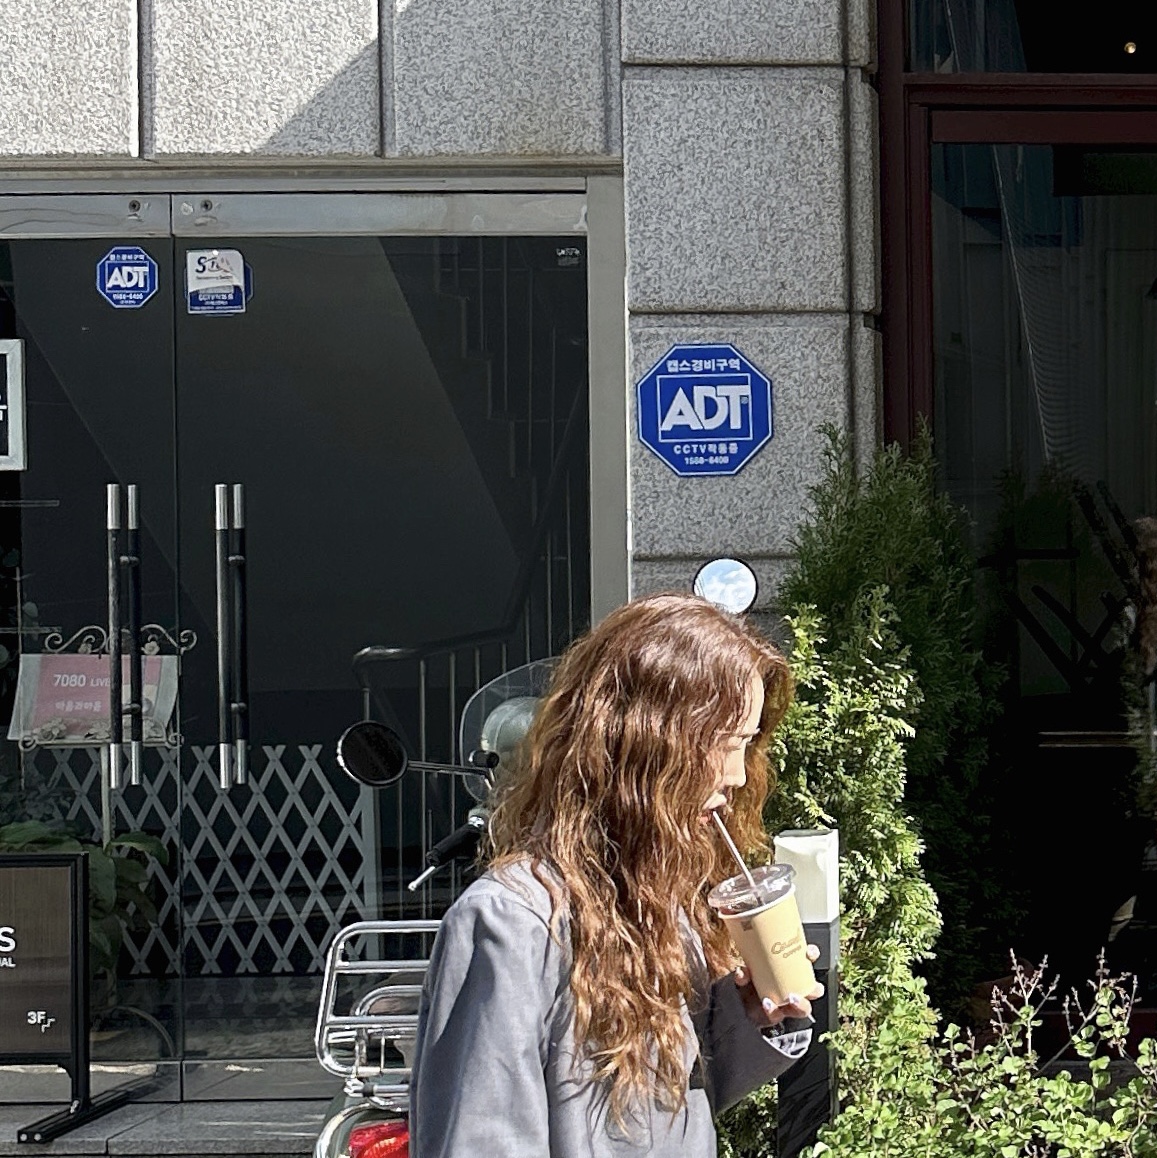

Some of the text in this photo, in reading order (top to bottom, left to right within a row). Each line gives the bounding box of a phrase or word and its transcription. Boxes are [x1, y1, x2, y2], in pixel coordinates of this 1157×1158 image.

[106, 266, 149, 288] ADT
[666, 358, 742, 372] 캡스경비구역
[660, 384, 751, 431] ADT
[673, 443, 739, 455] CCTV작동중
[53, 674, 86, 687] 7080
[27, 1011, 46, 1024] 3F
